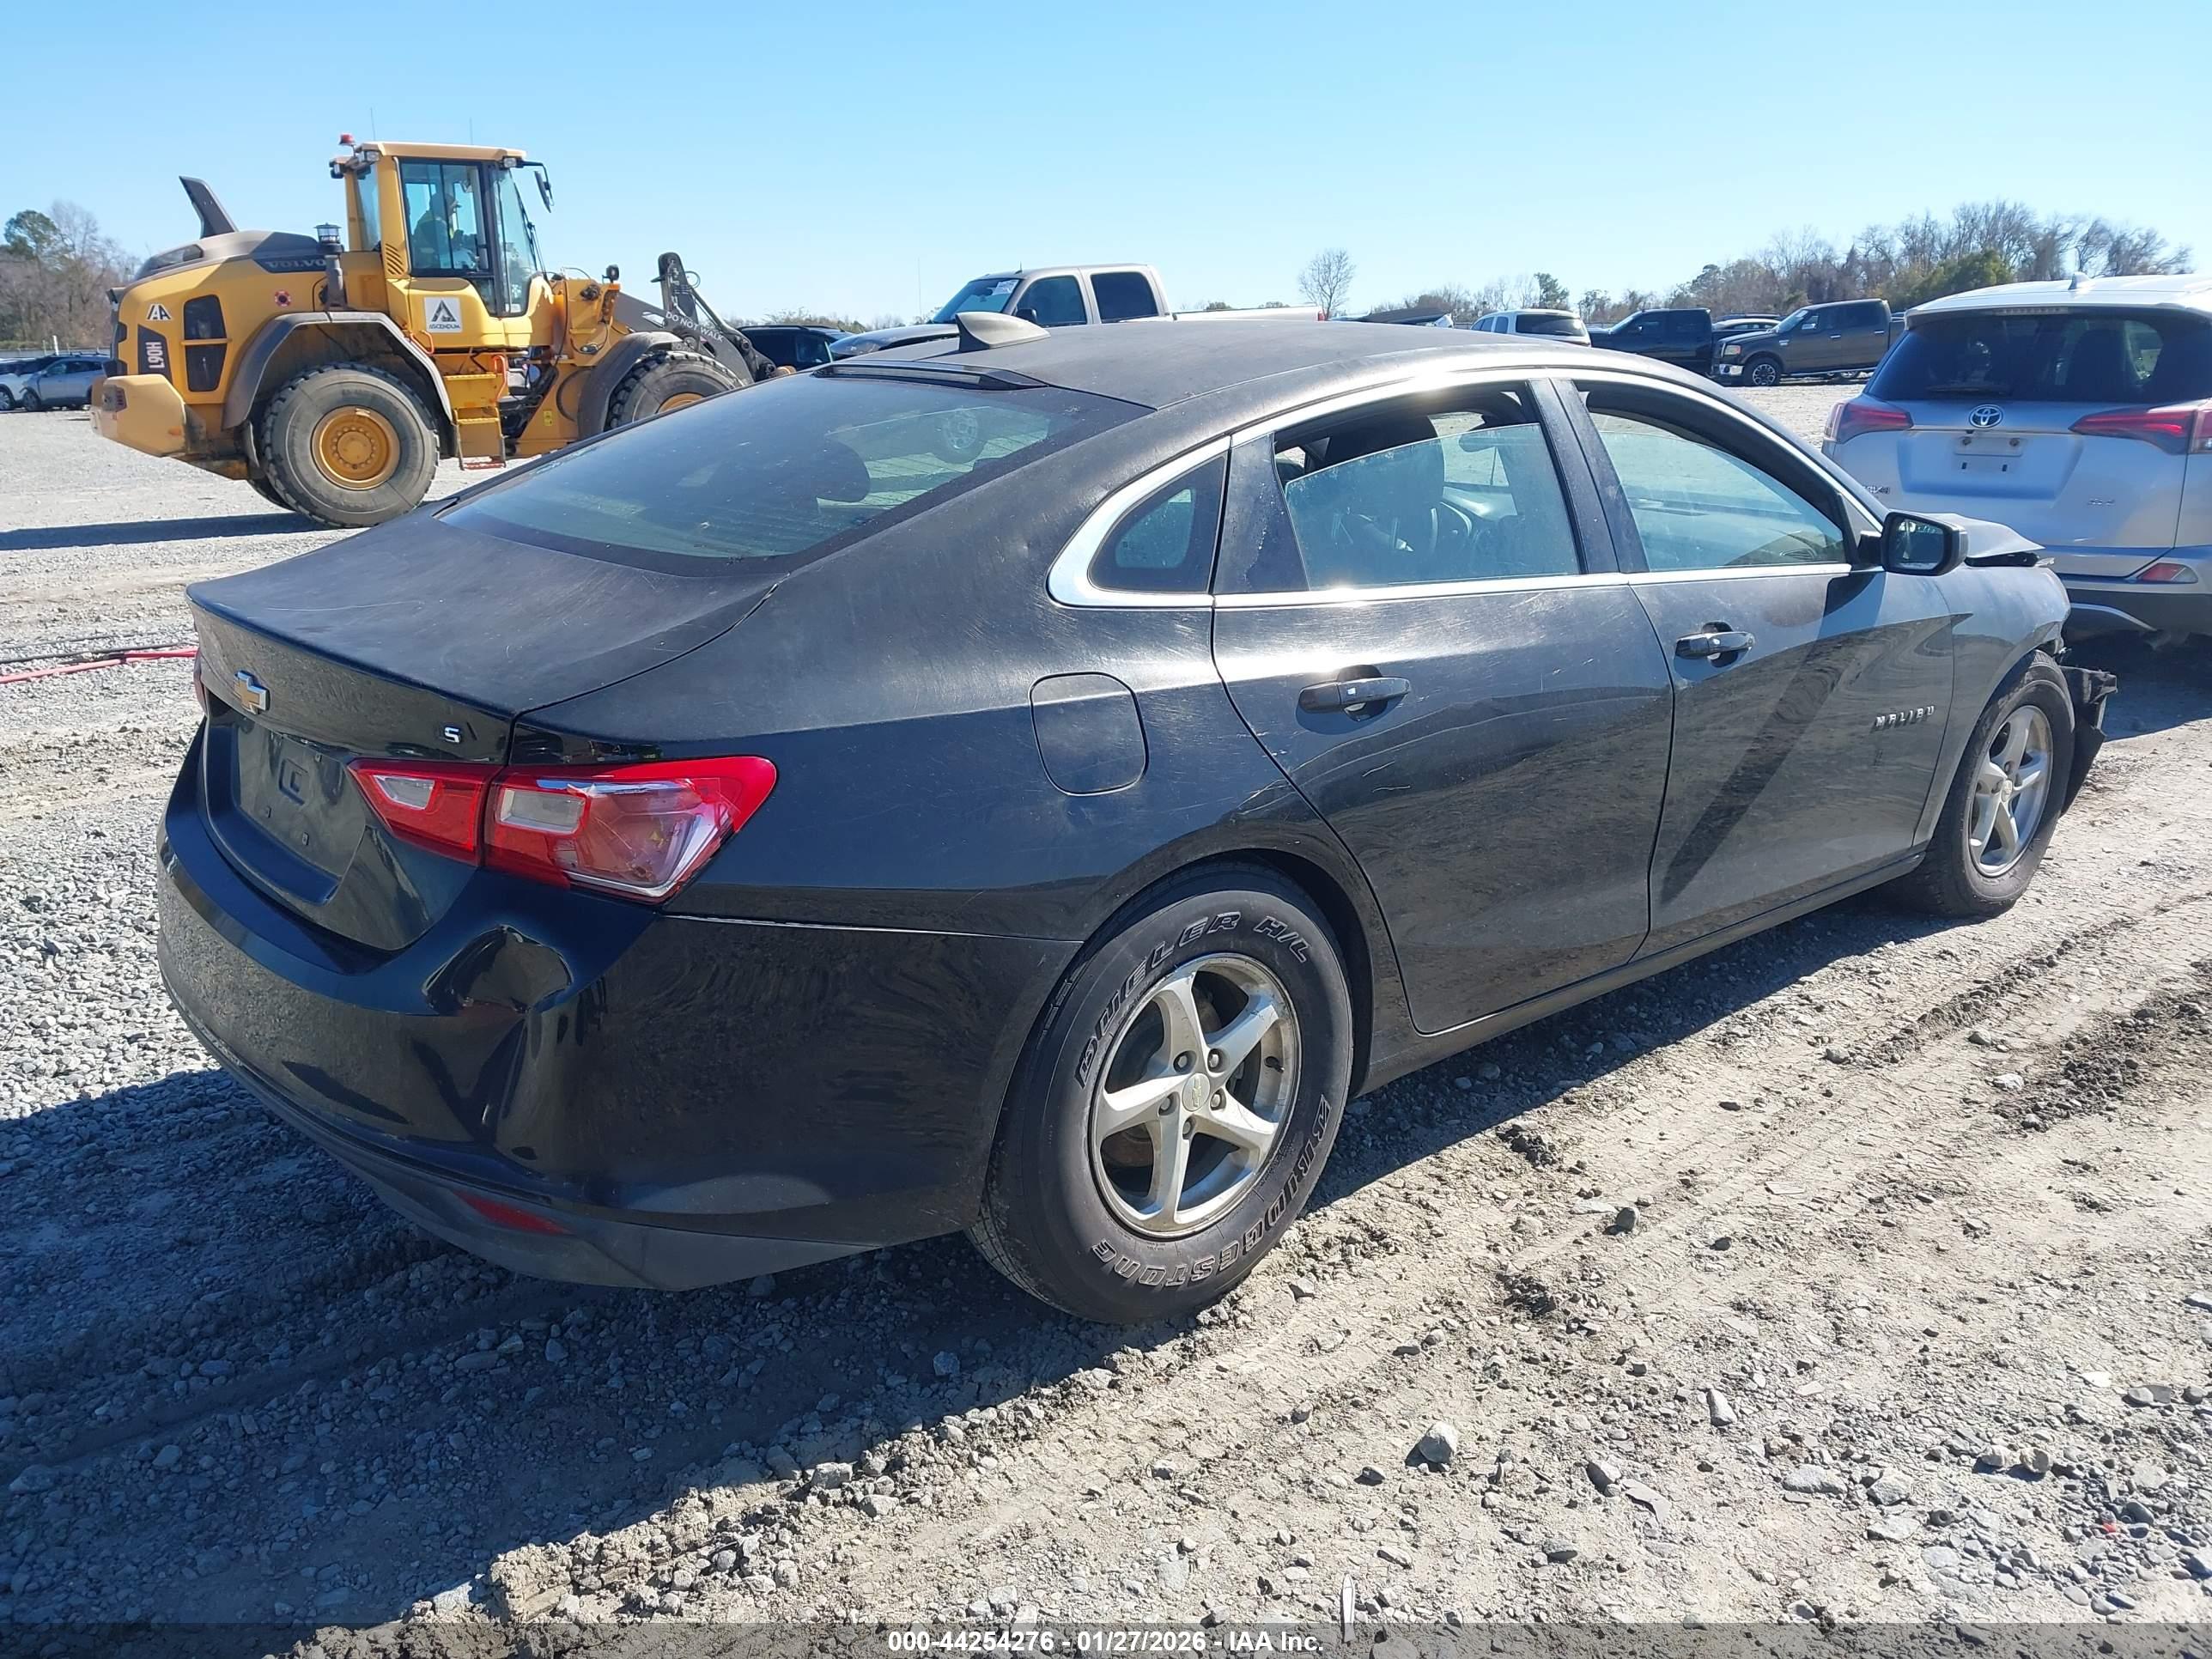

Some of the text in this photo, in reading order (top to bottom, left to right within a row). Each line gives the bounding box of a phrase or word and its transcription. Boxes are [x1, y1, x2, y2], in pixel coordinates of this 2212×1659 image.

[265, 258, 327, 269] VOLVO
[665, 311, 725, 342] DO NOT WALK
[145, 342, 165, 368] L90H
[1875, 705, 1935, 727] MALIBU
[444, 726, 460, 744] S
[1074, 911, 1311, 1089] DUELER H/L
[1091, 1093, 1332, 1286] BRIDGESTONE
